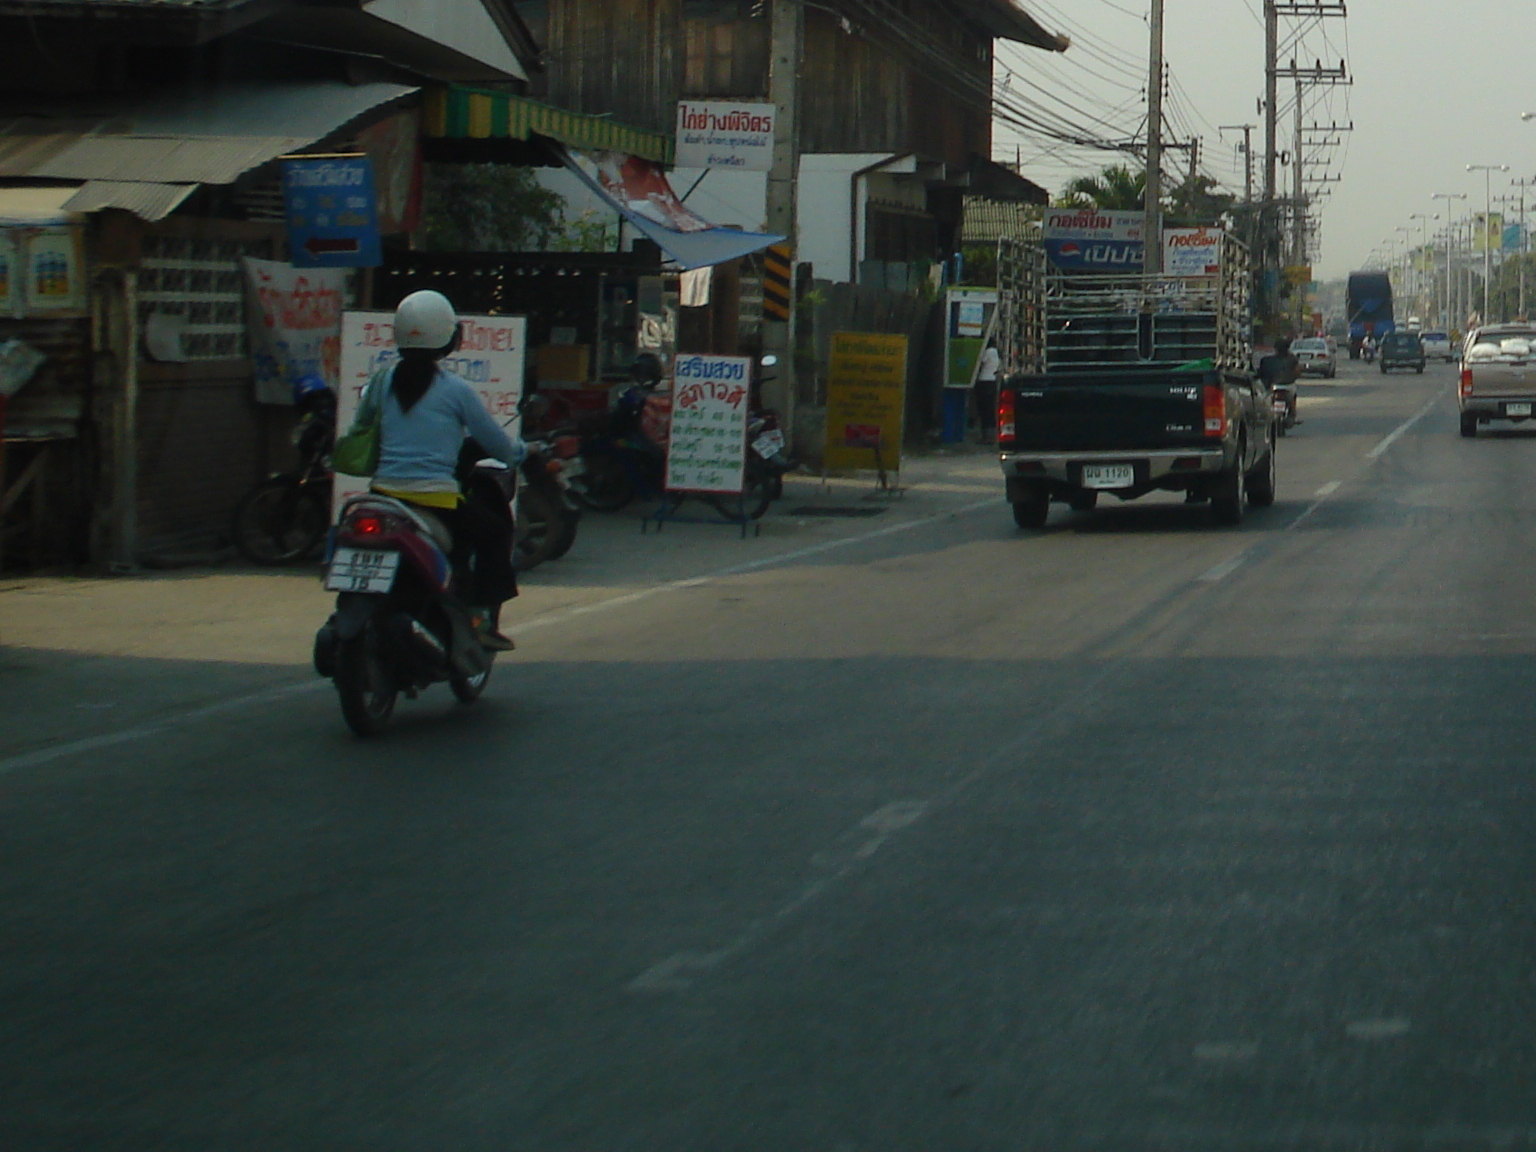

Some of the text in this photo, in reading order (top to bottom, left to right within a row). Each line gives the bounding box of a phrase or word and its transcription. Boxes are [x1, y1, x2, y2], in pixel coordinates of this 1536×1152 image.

[681, 105, 771, 133] ไก่ย่างพิจิตร
[675, 357, 744, 381] เสริมสวย
